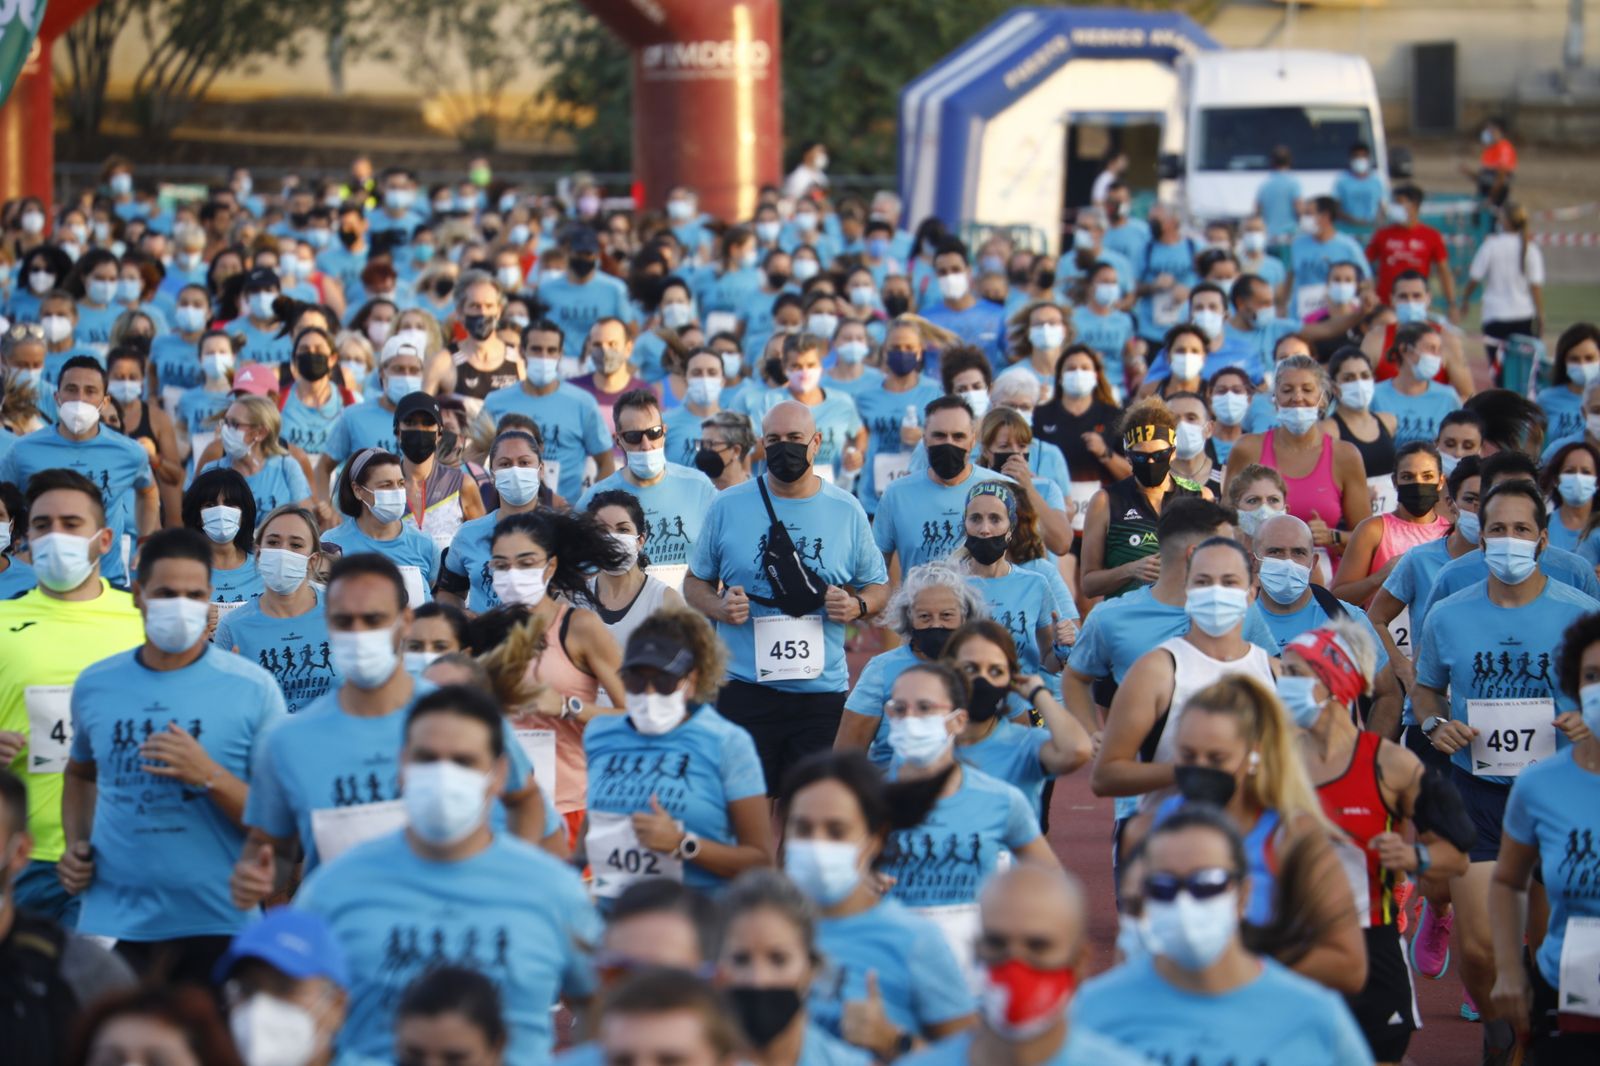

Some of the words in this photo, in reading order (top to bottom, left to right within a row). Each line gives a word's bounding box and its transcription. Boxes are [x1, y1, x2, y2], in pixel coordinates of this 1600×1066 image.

[770, 640, 810, 660] 453
[1487, 728, 1536, 753] 497
[607, 847, 661, 875] 402
